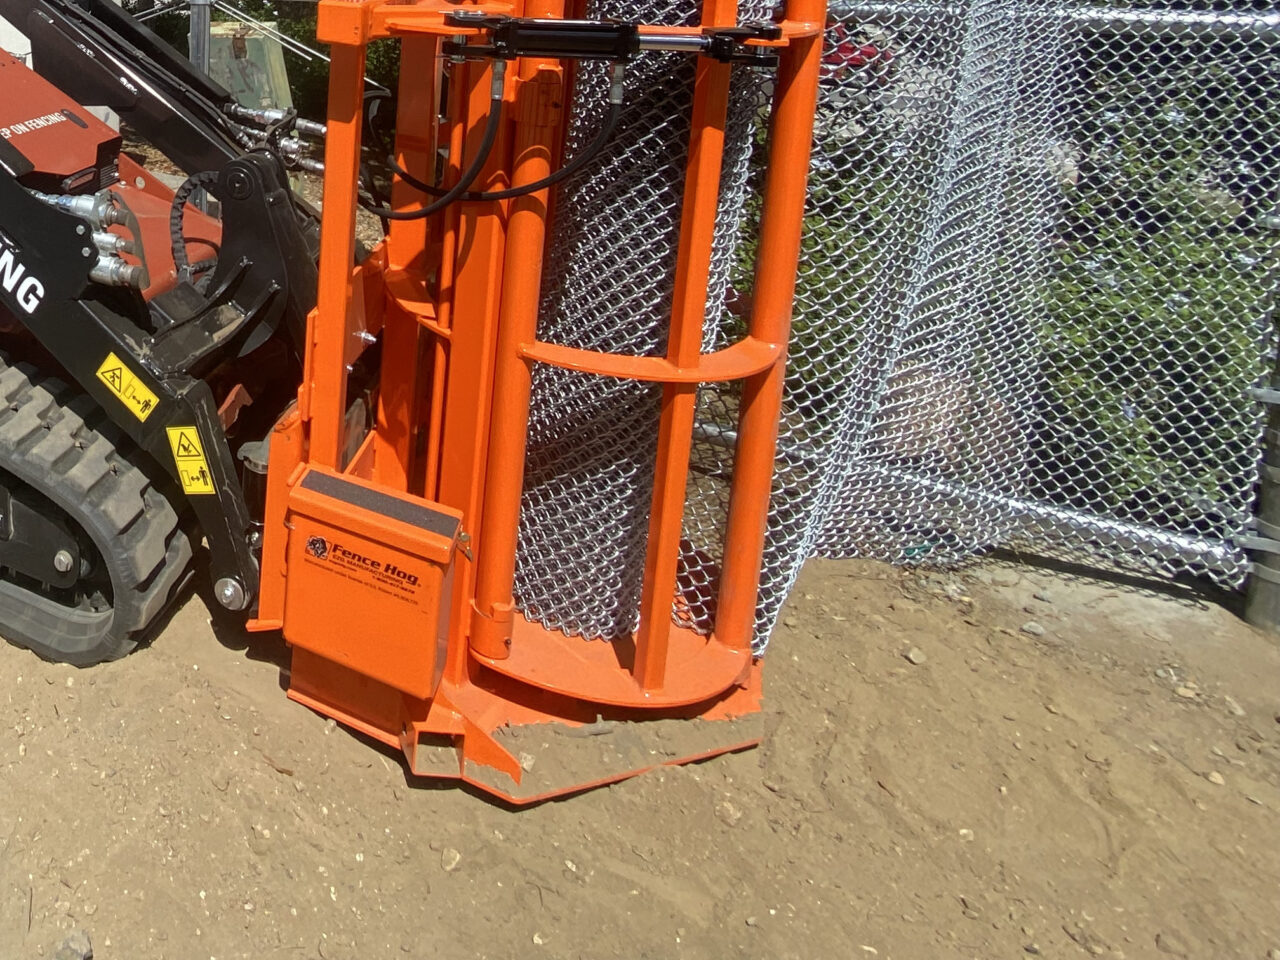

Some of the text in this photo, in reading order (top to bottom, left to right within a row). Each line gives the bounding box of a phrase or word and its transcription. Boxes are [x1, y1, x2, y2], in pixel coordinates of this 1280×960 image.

[9, 122, 30, 135] ON
[23, 112, 67, 131] FENCING
[332, 544, 381, 570] Fence
[384, 563, 419, 586] Hog
